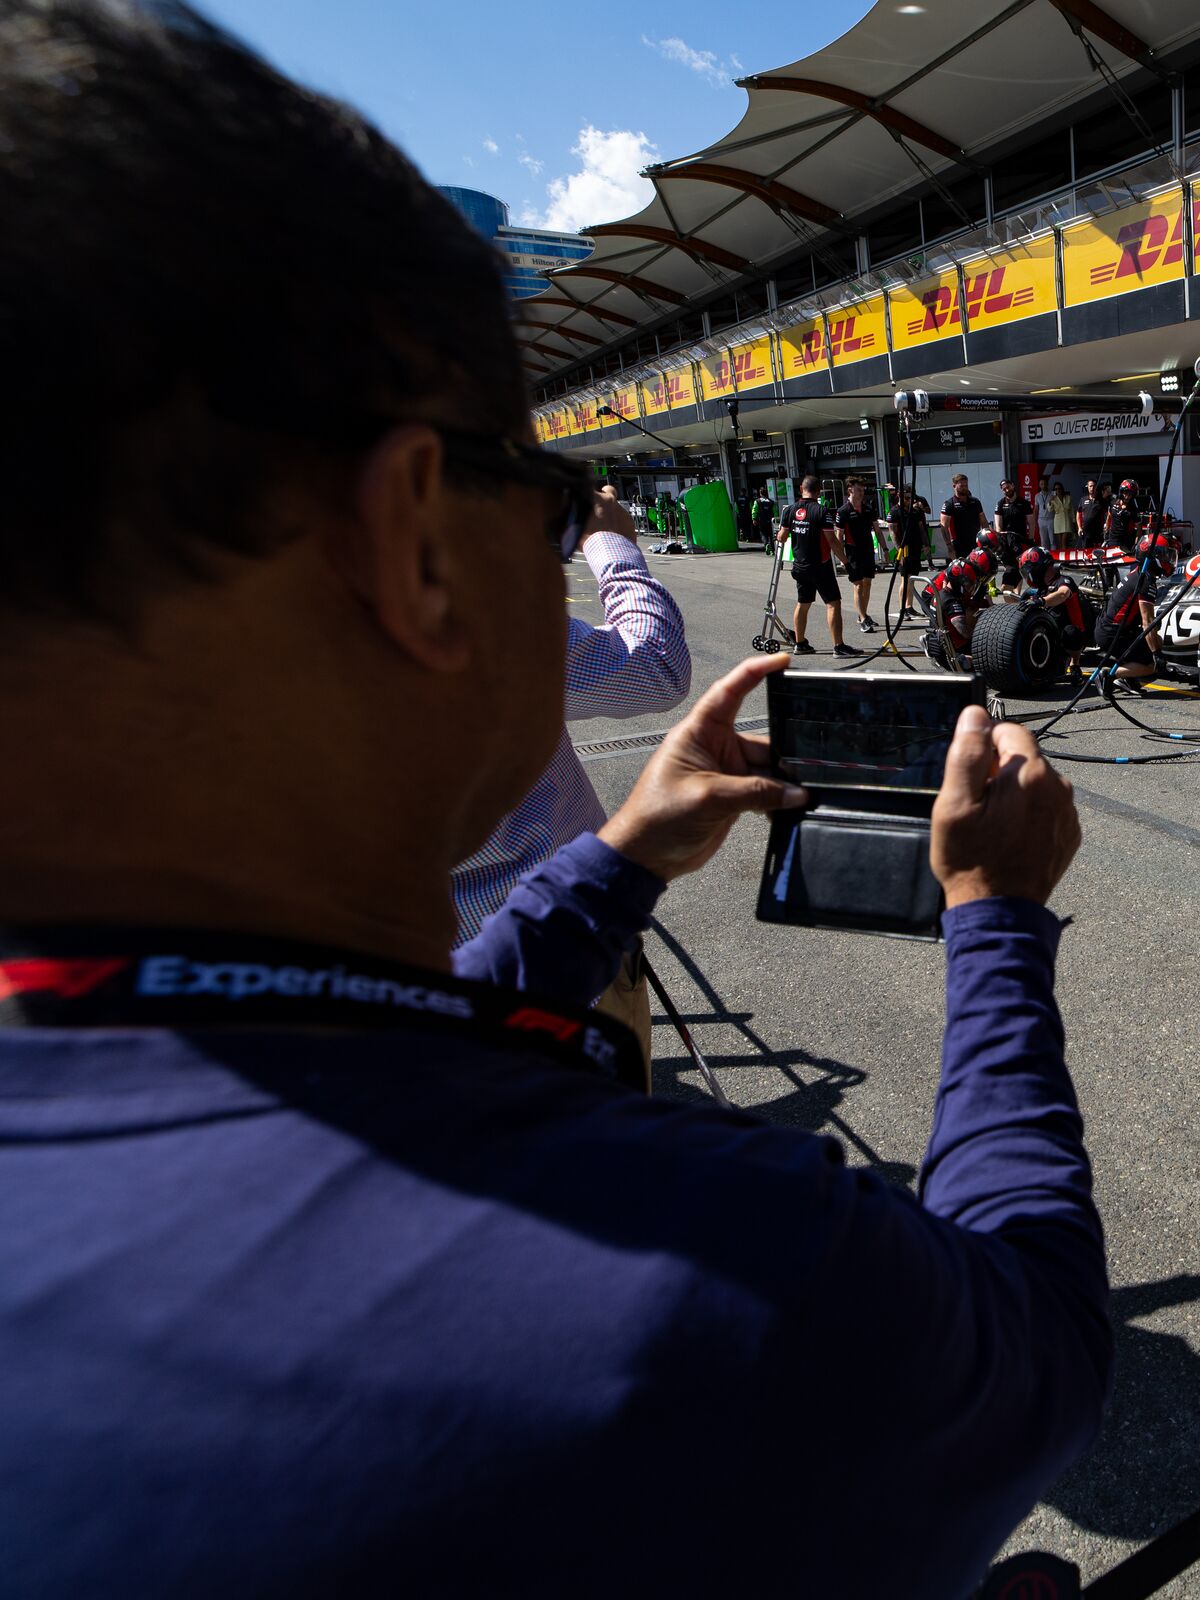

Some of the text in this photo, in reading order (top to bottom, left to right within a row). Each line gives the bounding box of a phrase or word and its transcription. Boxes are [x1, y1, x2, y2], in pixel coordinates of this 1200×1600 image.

[532, 257, 555, 267] Hilton
[922, 267, 1014, 332] DHL
[802, 317, 862, 364] DHL
[715, 352, 757, 388] DHL
[960, 398, 999, 407] MoneyGram
[1054, 419, 1090, 435] OLIVER
[1090, 414, 1149, 430] BEARMAN
[809, 445, 818, 458] 77
[845, 441, 867, 453] BOTTAS
[134, 955, 473, 1019] Experiences
